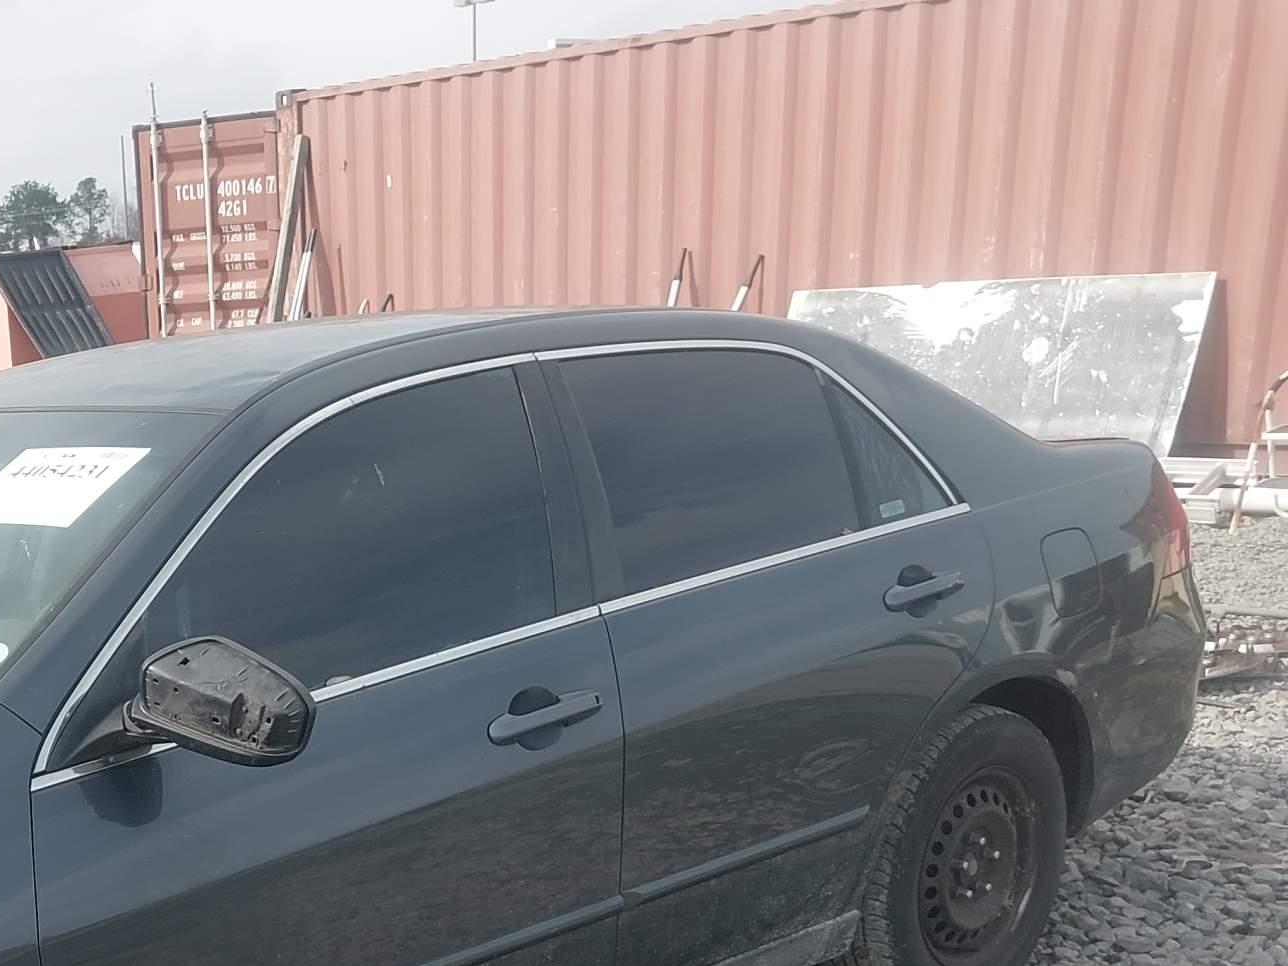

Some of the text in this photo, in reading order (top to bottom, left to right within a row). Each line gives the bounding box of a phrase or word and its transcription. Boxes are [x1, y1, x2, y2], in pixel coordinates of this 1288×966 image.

[175, 175, 277, 202] TCLU 400146 7
[217, 199, 248, 217] 42G1
